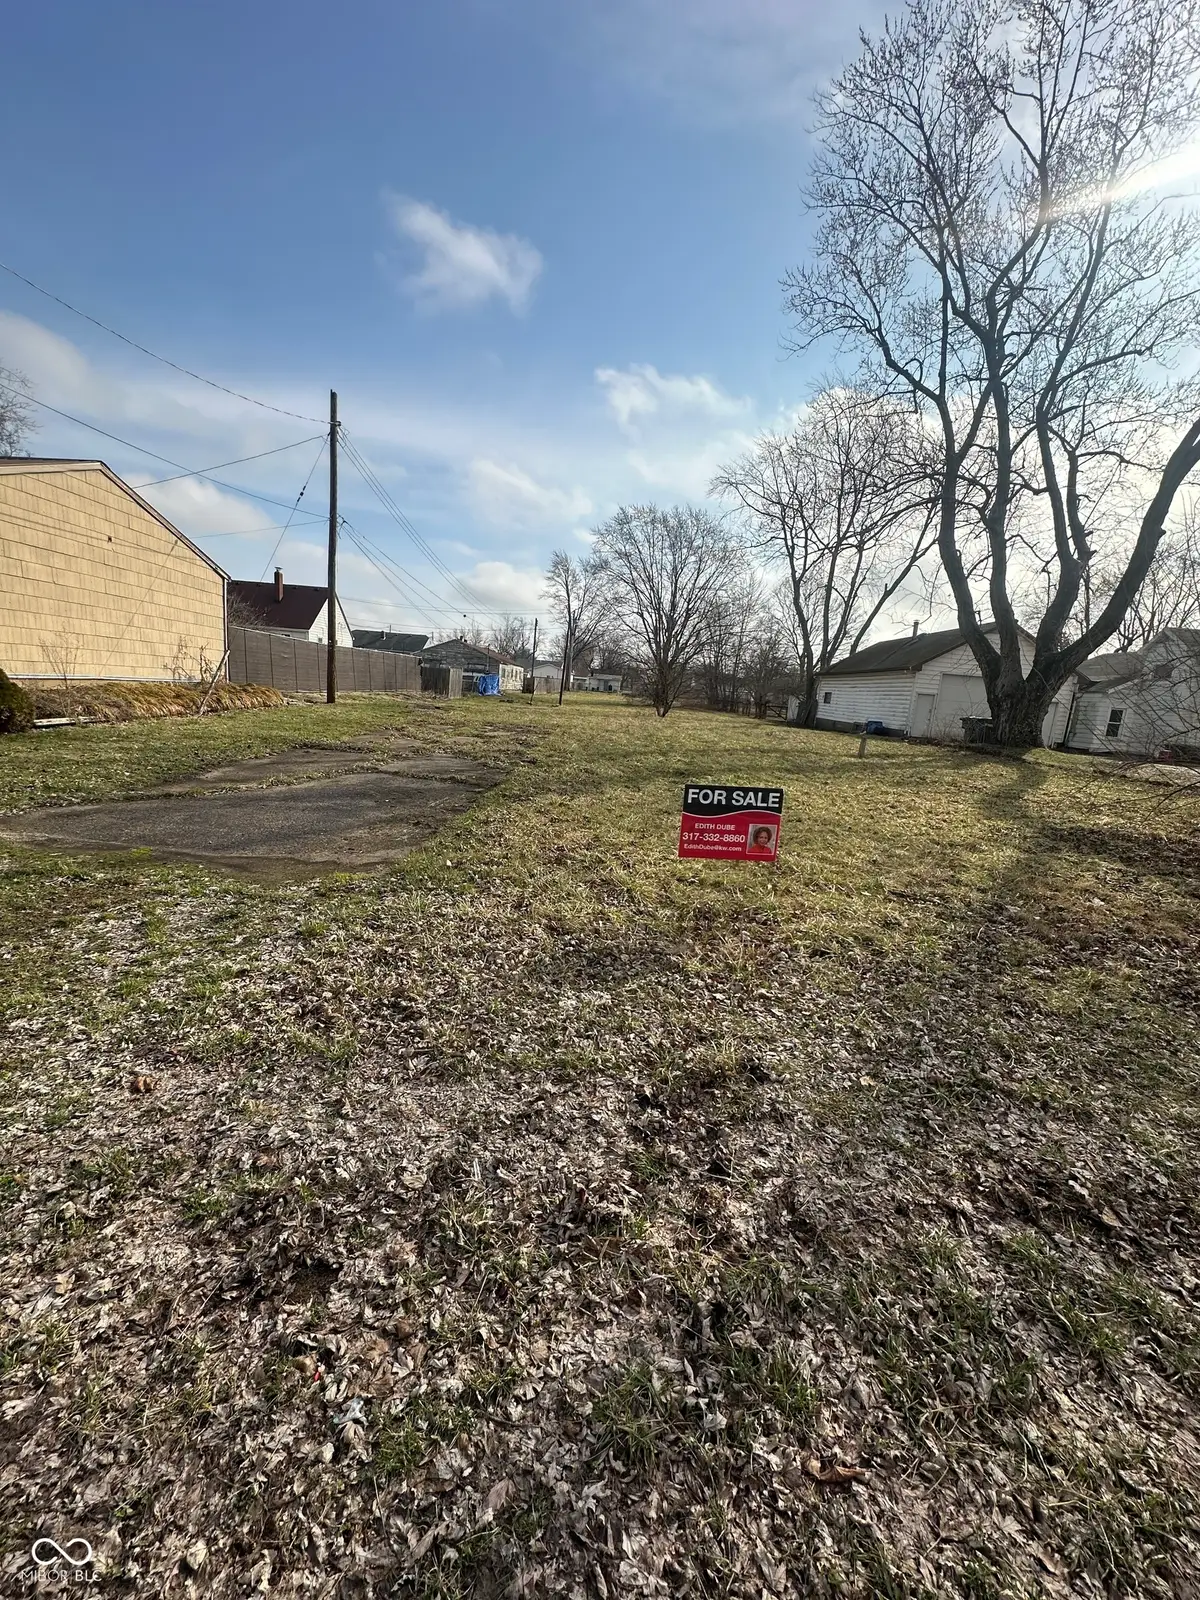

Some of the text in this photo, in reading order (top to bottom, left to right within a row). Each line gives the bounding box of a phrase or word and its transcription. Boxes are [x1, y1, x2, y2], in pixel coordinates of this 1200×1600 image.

[687, 789, 781, 808] FOR SALE
[716, 823, 736, 831] DUBE
[682, 832, 746, 843] 317-332-8860
[683, 843, 742, 852] EdithDube@kw.com
